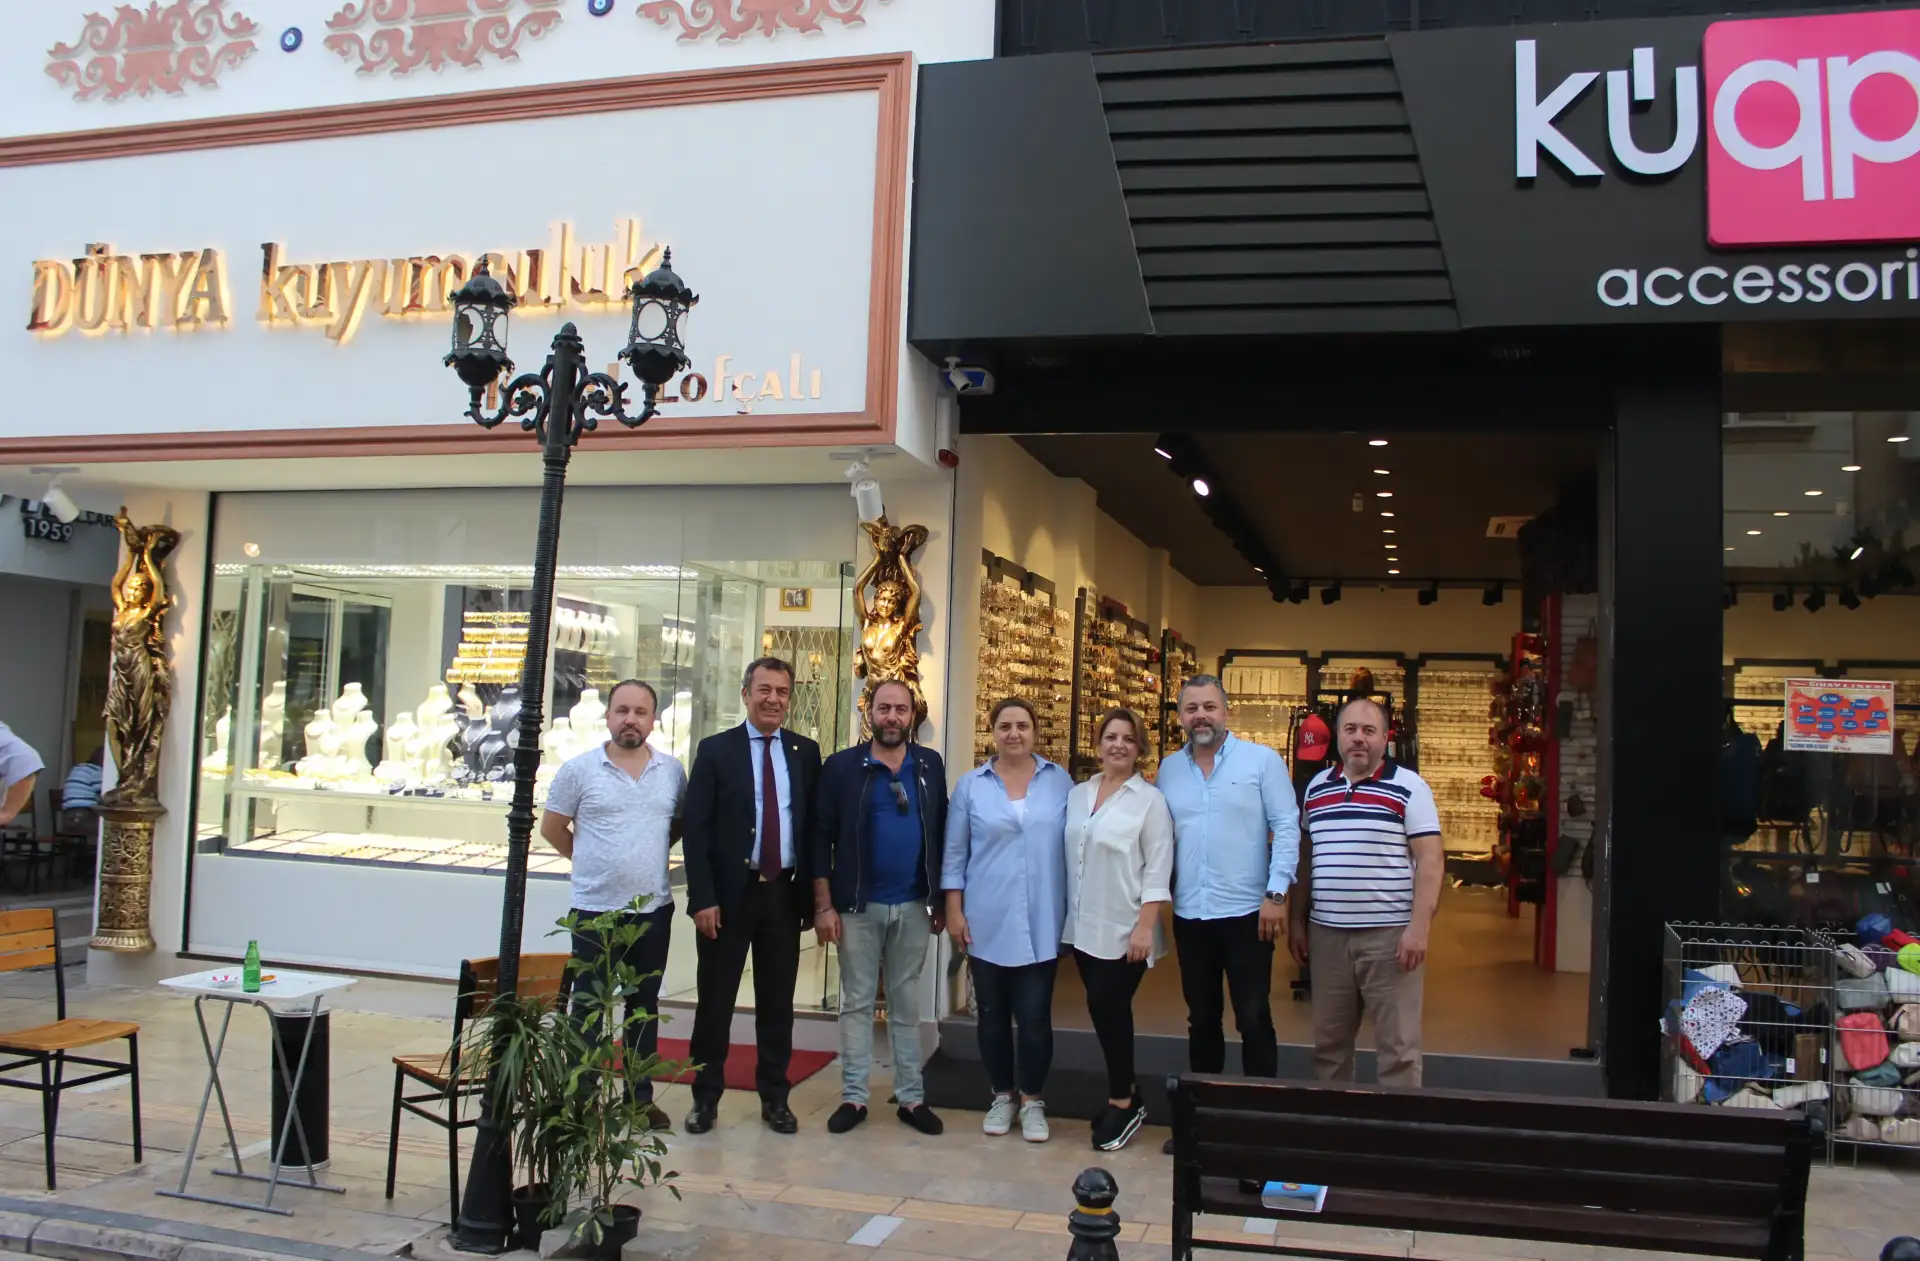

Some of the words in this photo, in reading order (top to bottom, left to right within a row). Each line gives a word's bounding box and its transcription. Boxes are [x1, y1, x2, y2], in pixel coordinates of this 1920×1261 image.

[27, 242, 230, 331] DÜNYA
[1596, 248, 1920, 307] accessori
[27, 518, 74, 542] 1959
